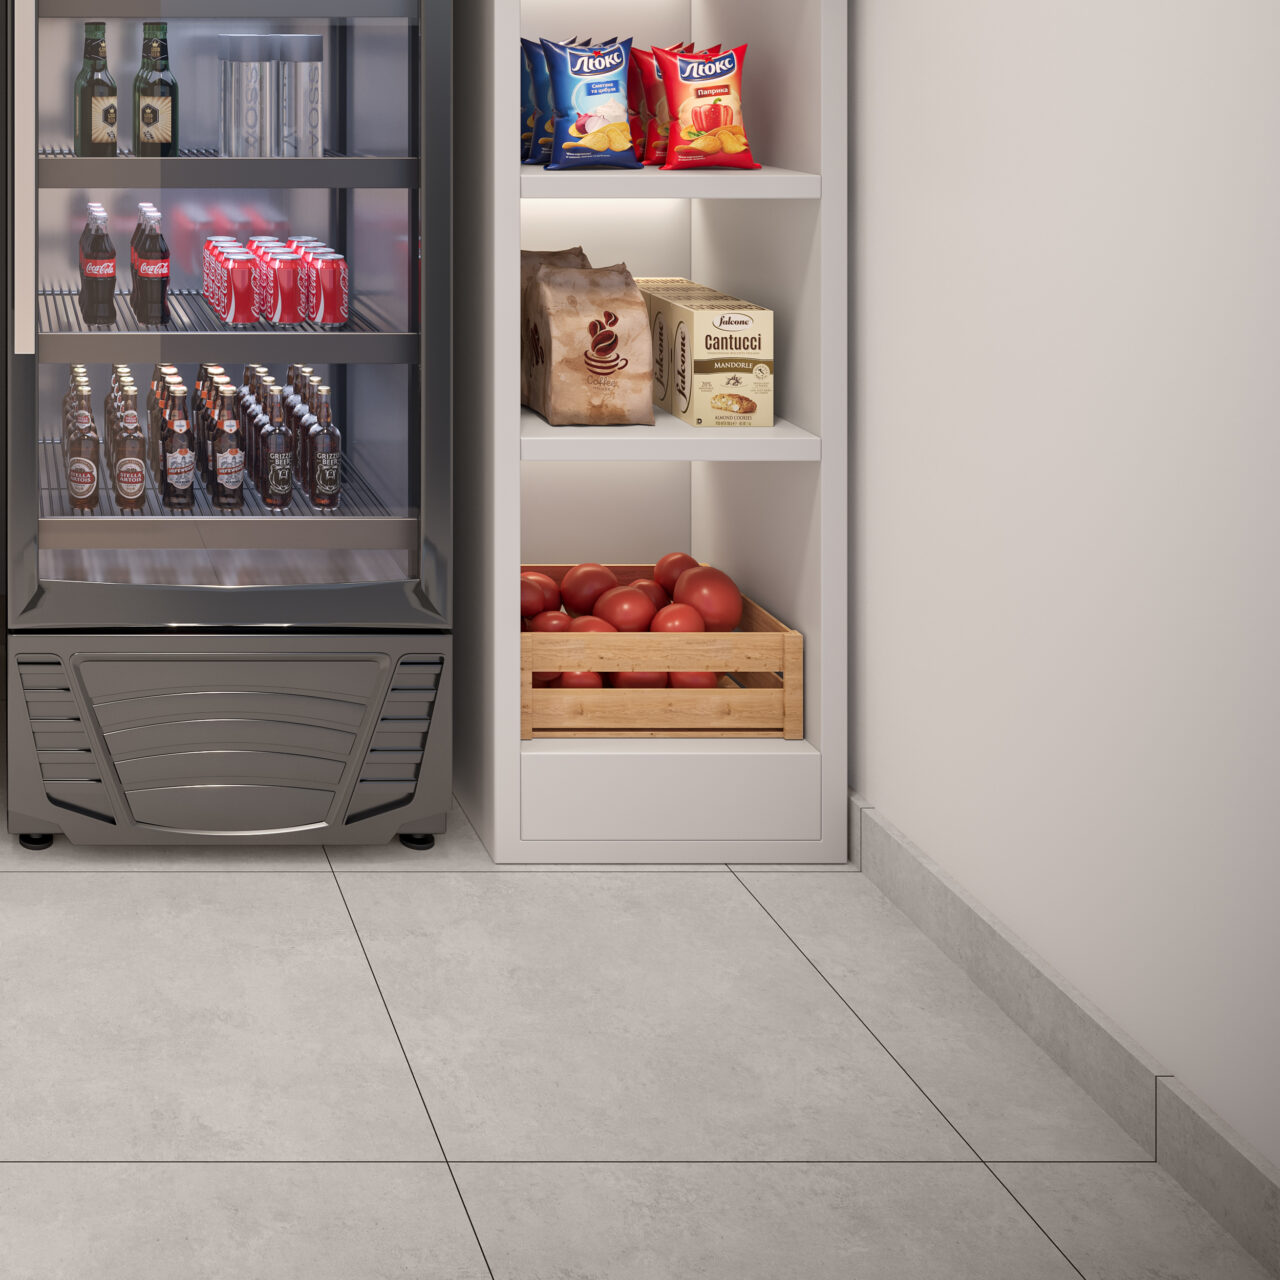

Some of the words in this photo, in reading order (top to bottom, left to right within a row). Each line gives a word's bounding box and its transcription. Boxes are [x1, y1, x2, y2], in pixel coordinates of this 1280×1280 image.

[697, 87, 729, 96] Паприка
[718, 315, 750, 327] falcone
[705, 333, 761, 350] Cantucci
[676, 330, 687, 401] falcone
